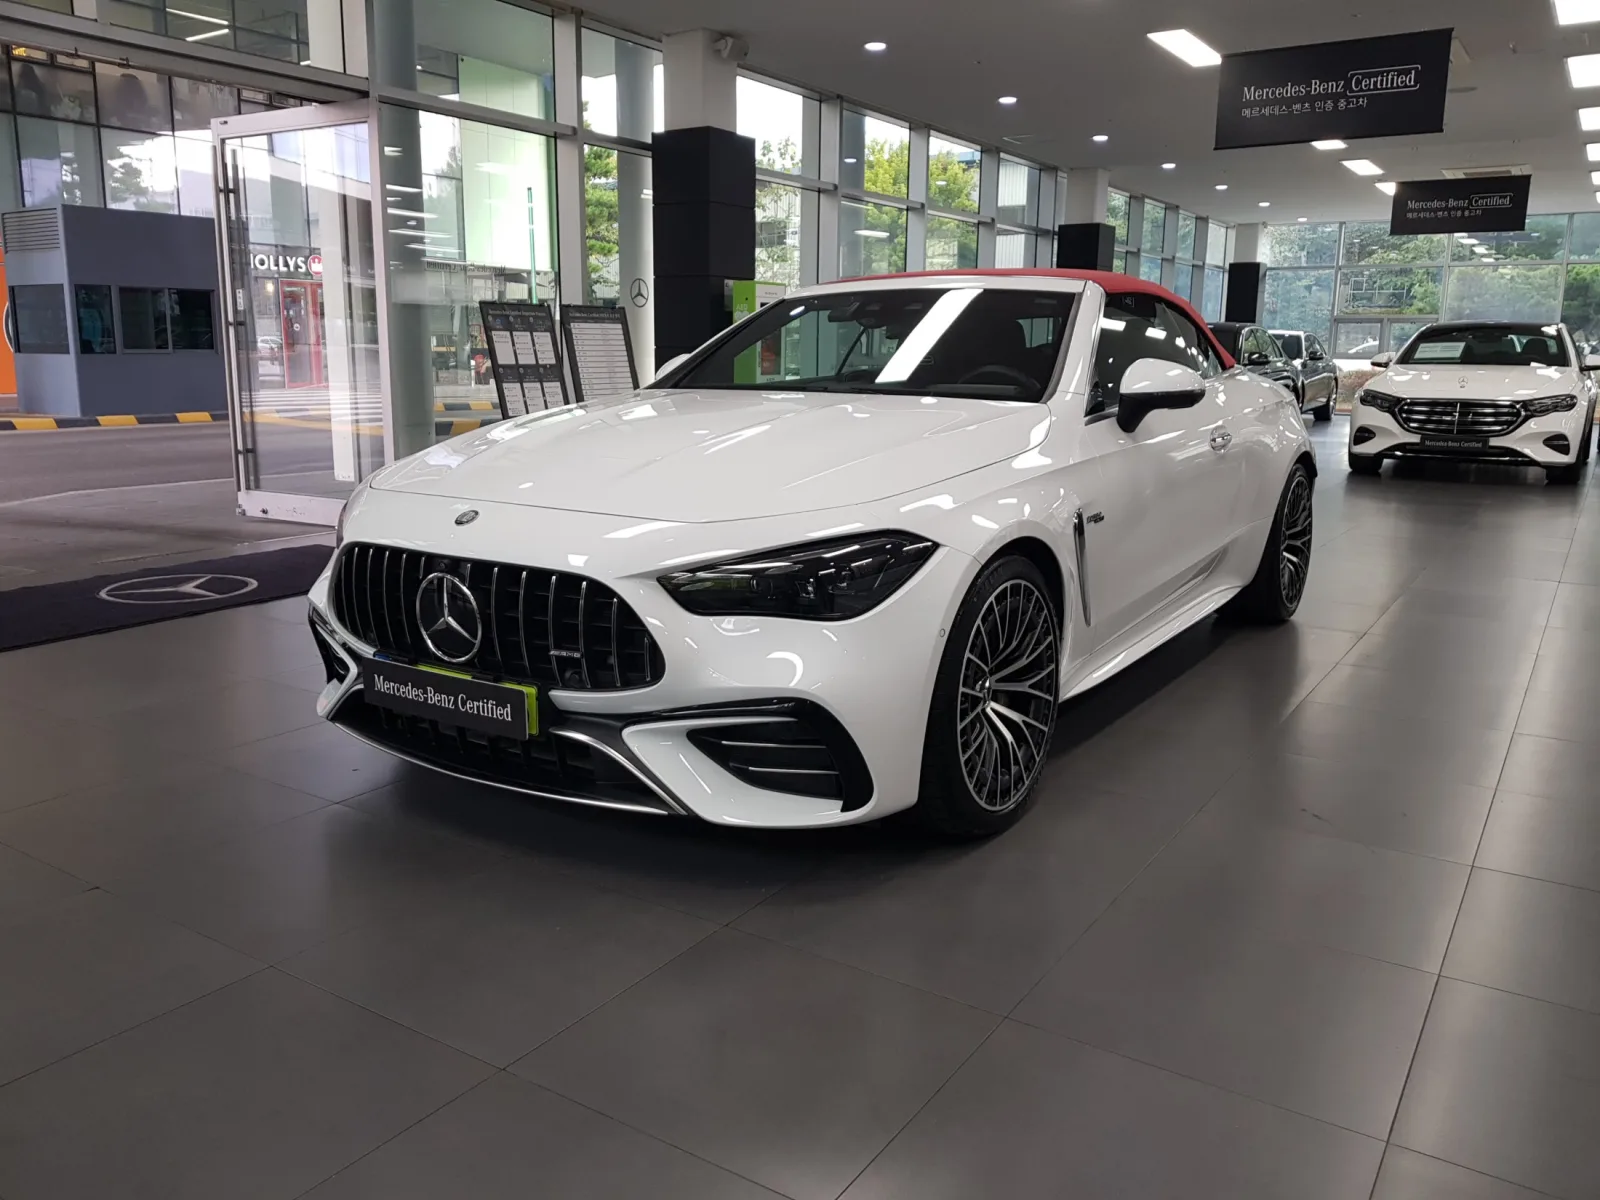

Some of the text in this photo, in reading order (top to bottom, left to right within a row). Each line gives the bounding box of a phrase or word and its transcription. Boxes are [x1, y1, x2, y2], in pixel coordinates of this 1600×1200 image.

[1242, 70, 1415, 102] Mercedes-Benz Certified
[1241, 97, 1367, 118] 메르세데스-벤츠 인증 중고차
[1407, 196, 1510, 210] Mercedes-Benz Certified
[374, 673, 513, 721] Mercedes-Benz Certified
